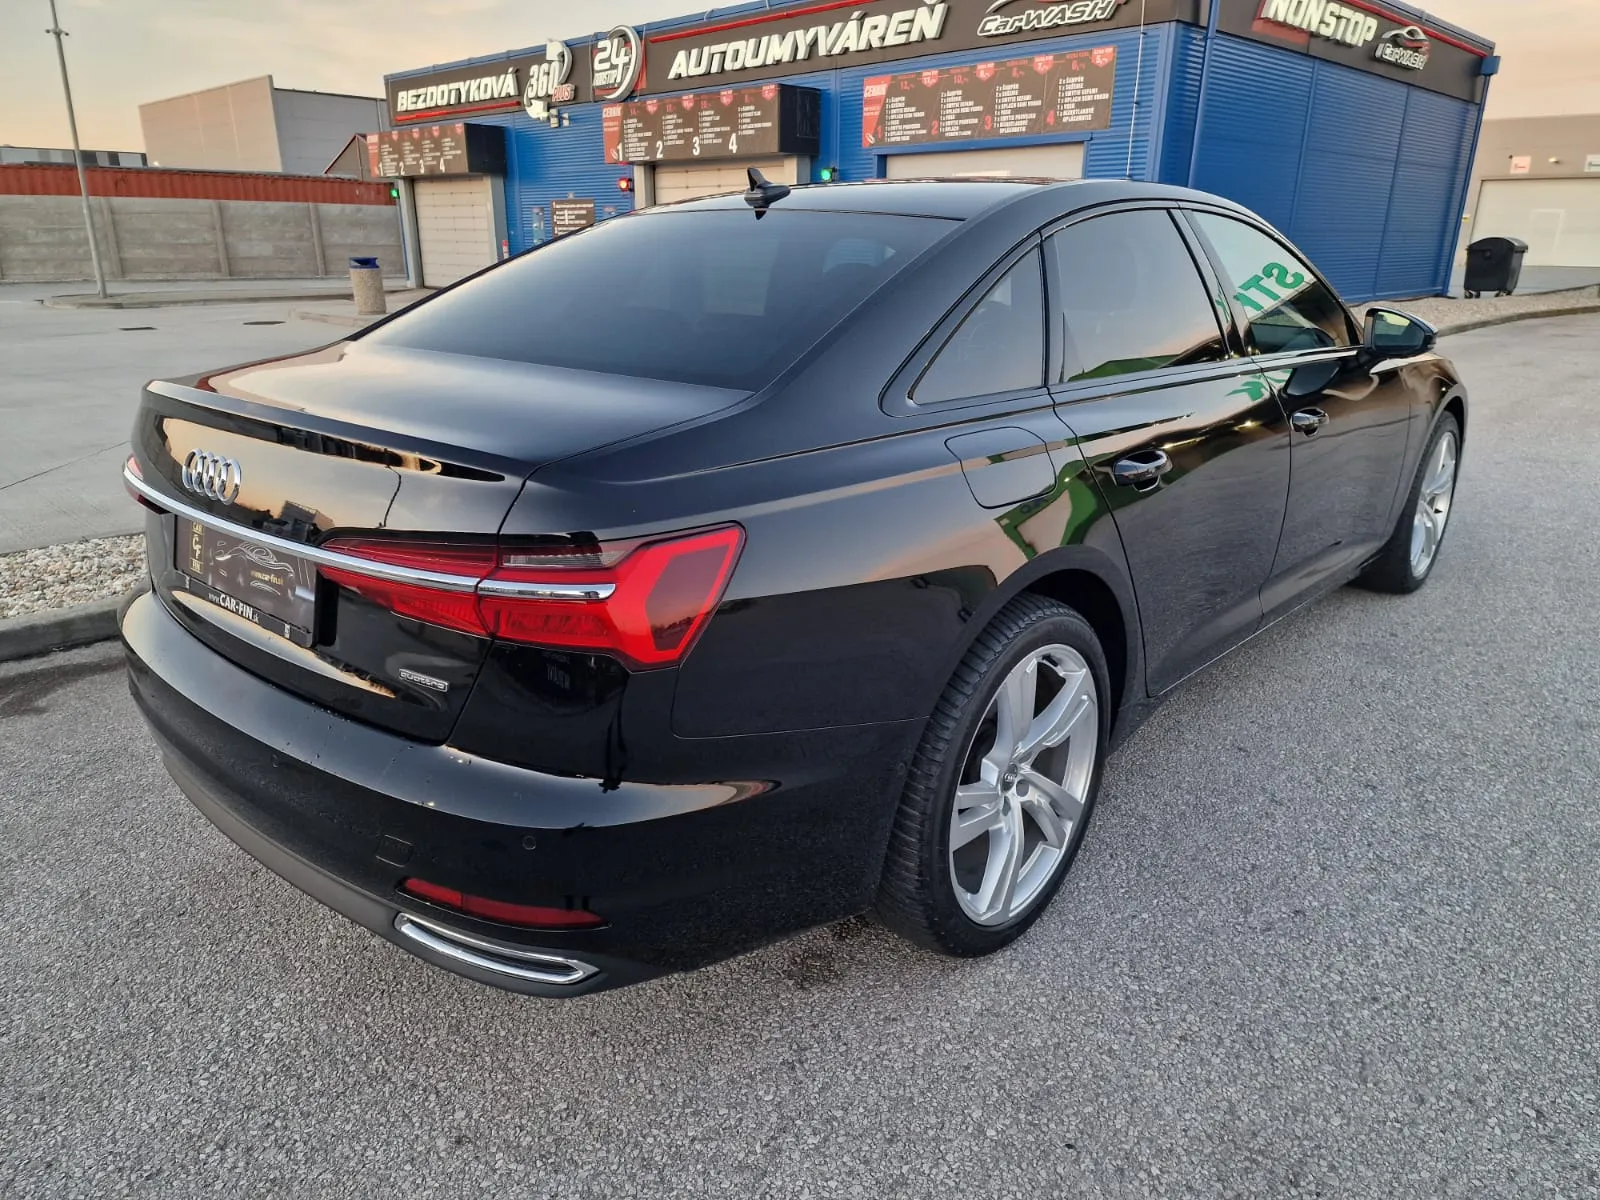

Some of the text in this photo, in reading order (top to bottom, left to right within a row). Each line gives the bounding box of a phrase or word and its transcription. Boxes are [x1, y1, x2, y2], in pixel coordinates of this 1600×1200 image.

[977, 0, 1117, 36] CarWASH
[1261, 0, 1378, 47] NONSTOP
[667, 0, 950, 80] AUTOUMYVÁREŇ
[593, 38, 630, 83] 24
[397, 67, 519, 112] BEZDOTYKOVÁ
[527, 60, 560, 98] 360
[552, 84, 572, 102] PLUS
[931, 120, 939, 135] 2
[617, 142, 623, 161] 1
[656, 140, 664, 159] 2
[692, 136, 700, 156] 3
[728, 133, 738, 154] 4
[400, 671, 446, 690] quattro
